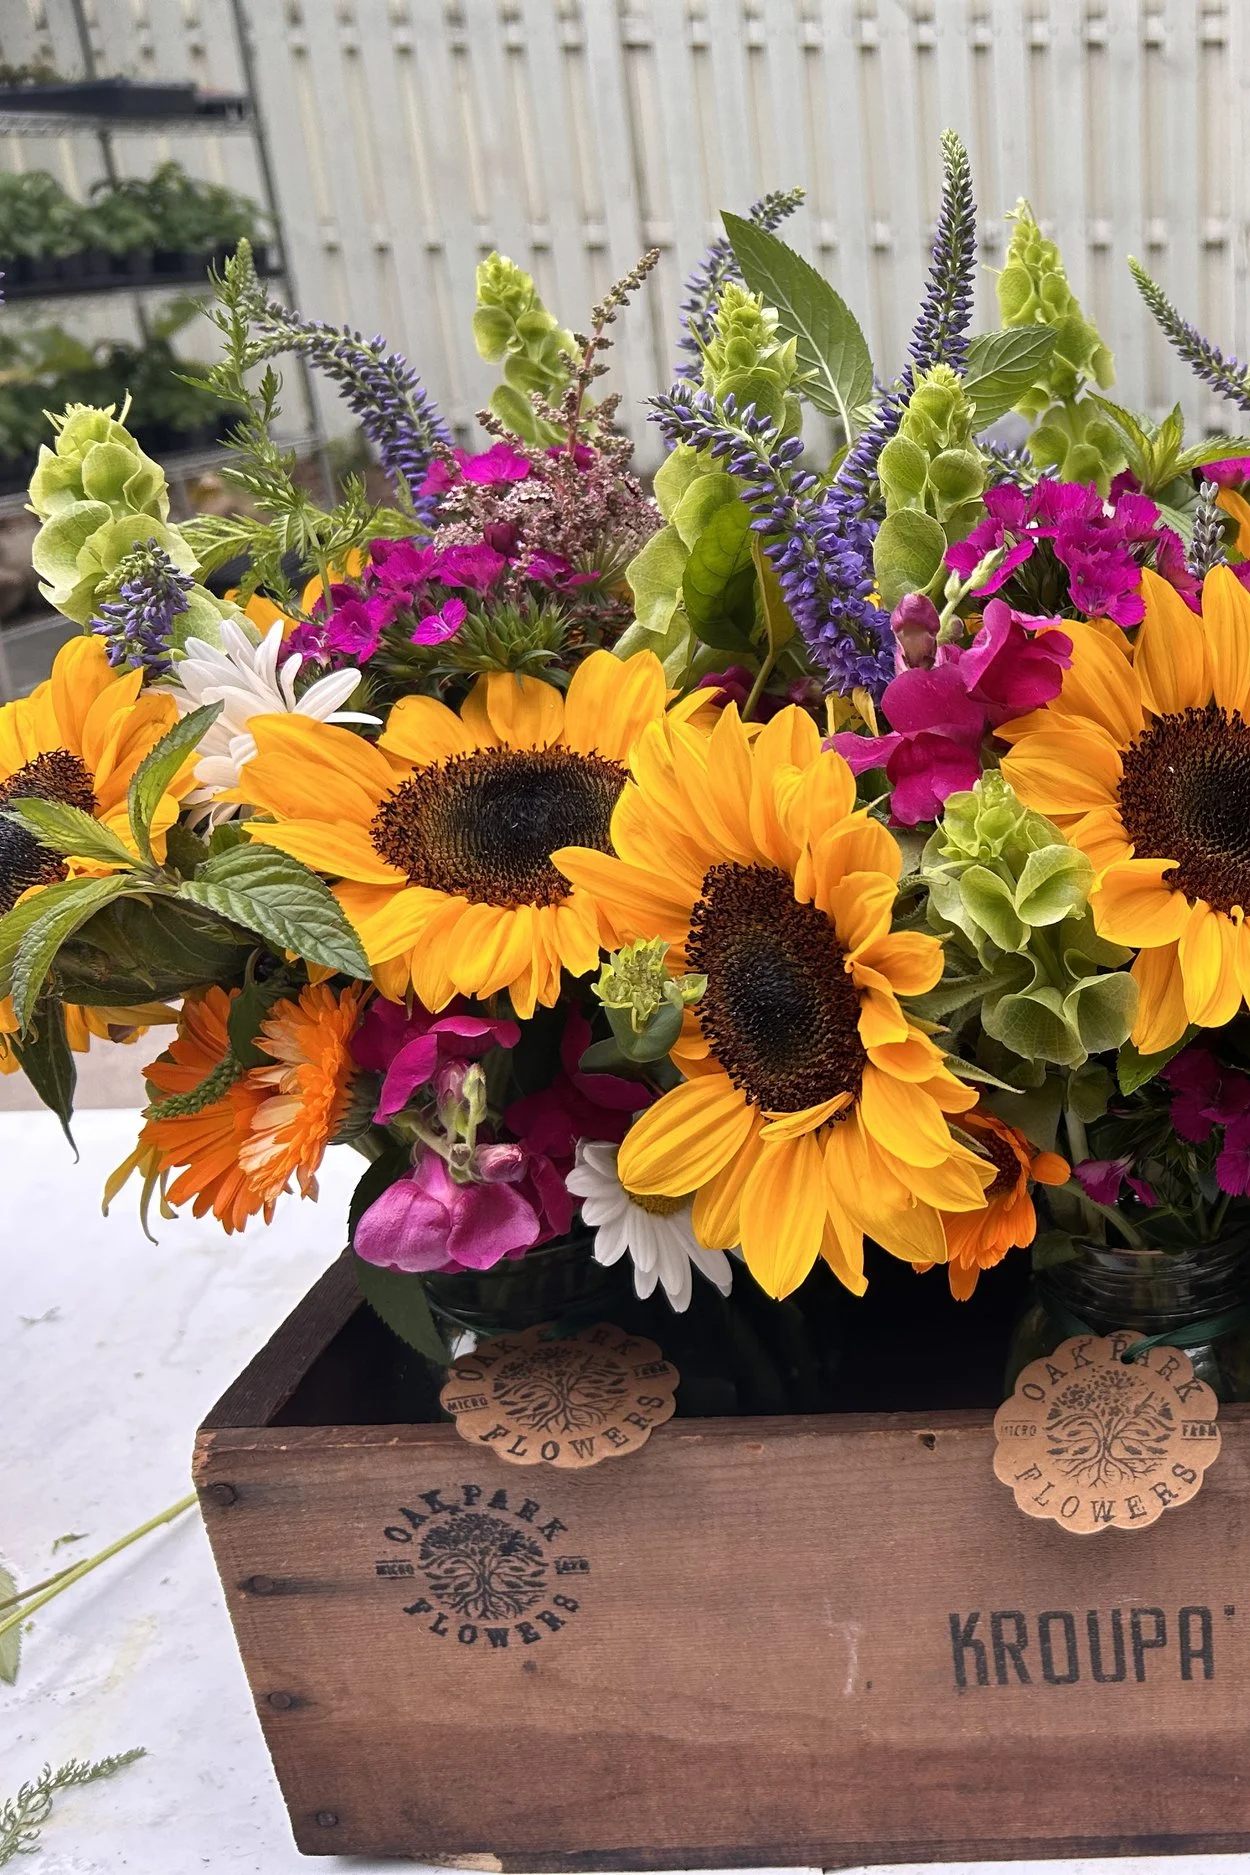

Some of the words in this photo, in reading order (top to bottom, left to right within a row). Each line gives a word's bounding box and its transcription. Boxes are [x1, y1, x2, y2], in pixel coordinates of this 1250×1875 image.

[455, 1339, 521, 1381] OAK
[1022, 1338, 1094, 1403] OAK
[1110, 1335, 1204, 1403] PARK
[447, 1397, 488, 1412] MICRO
[479, 1395, 664, 1460] FLOWERS
[383, 1489, 461, 1543] OAK
[462, 1484, 568, 1542] PARK
[1014, 1462, 1197, 1523] FLOWERS
[402, 1594, 580, 1648] FLOWERS
